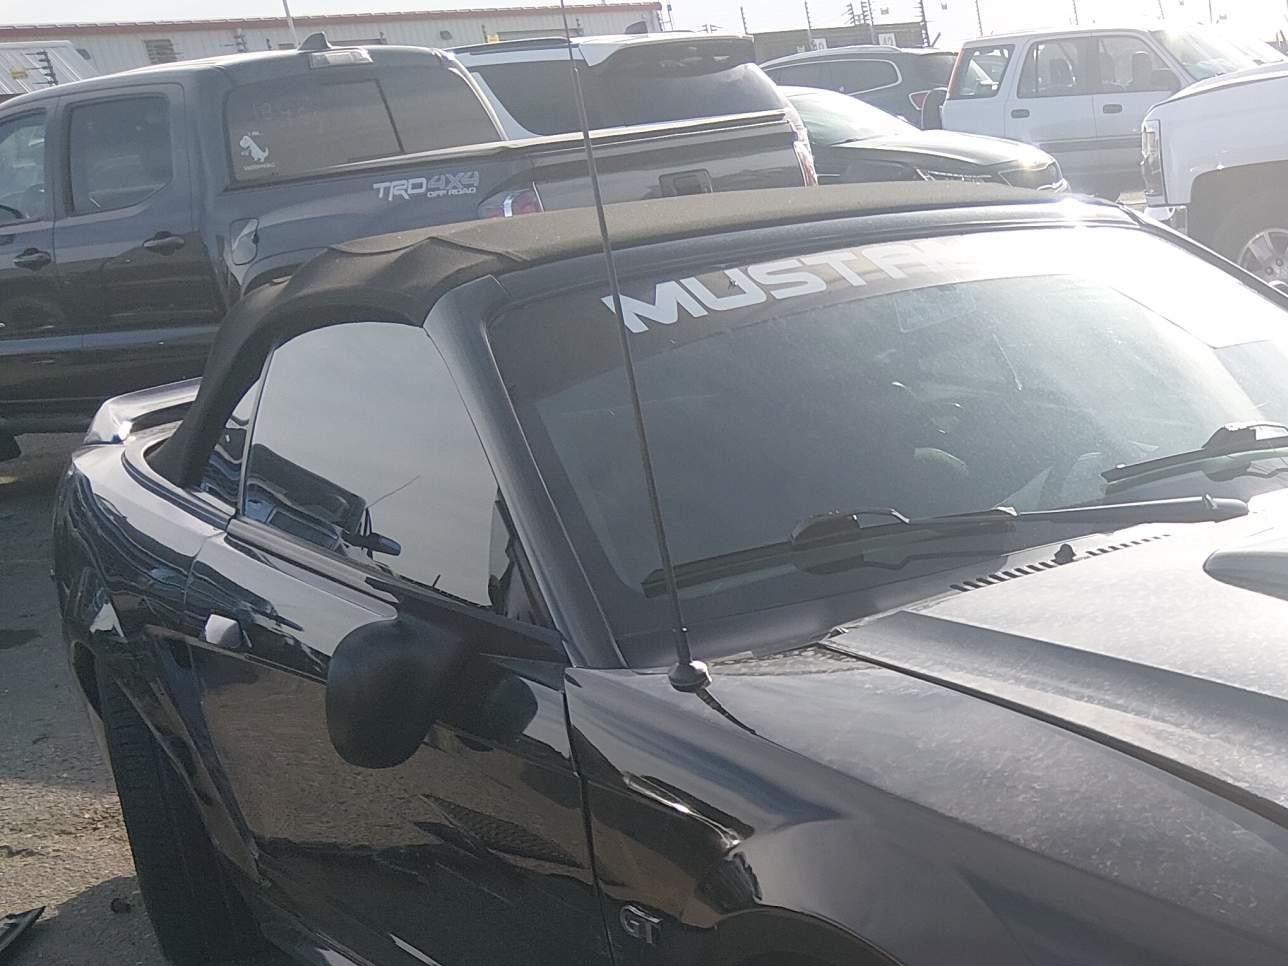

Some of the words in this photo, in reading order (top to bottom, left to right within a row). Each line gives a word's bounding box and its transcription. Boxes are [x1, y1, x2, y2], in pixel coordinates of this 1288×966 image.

[373, 178, 427, 202] TRD
[427, 190, 448, 199] OFF
[448, 187, 478, 197] ROAD
[620, 904, 662, 944] GT
